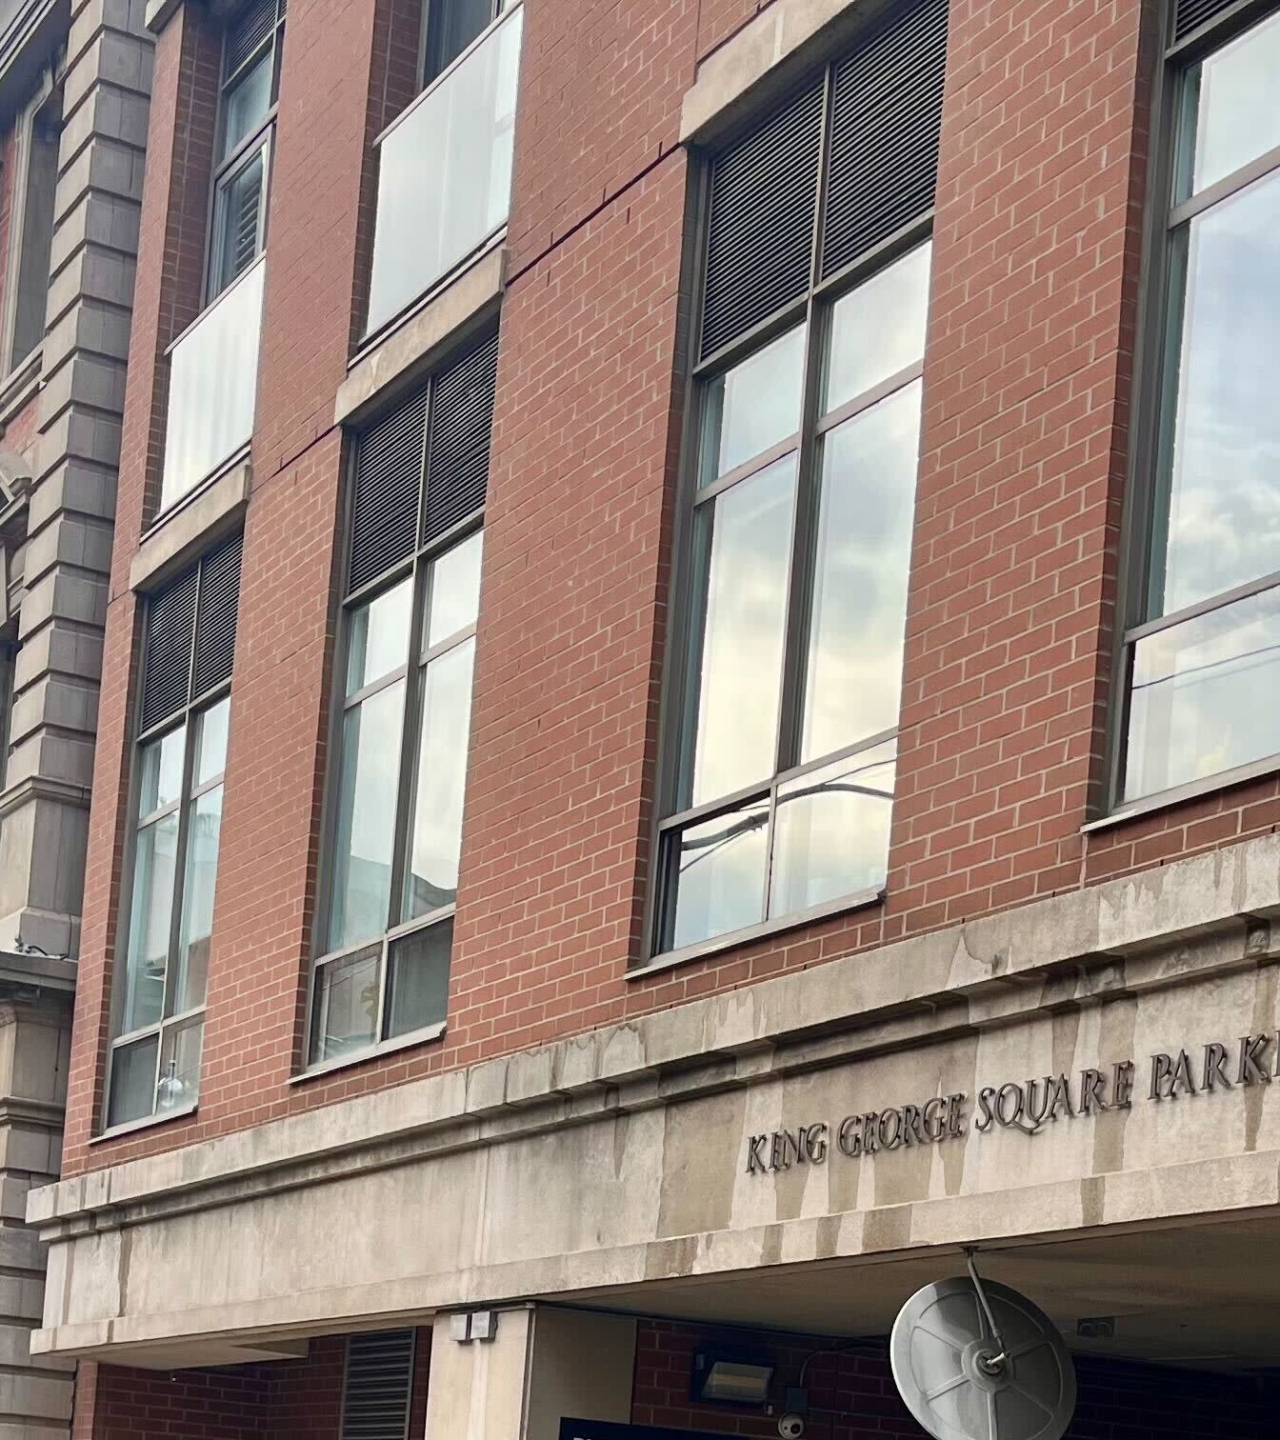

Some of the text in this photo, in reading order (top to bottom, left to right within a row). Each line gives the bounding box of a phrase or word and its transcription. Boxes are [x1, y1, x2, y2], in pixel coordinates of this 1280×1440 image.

[744, 1122, 828, 1176] KING
[836, 1092, 968, 1158] GEORGE
[974, 1060, 1135, 1136] SQUARE
